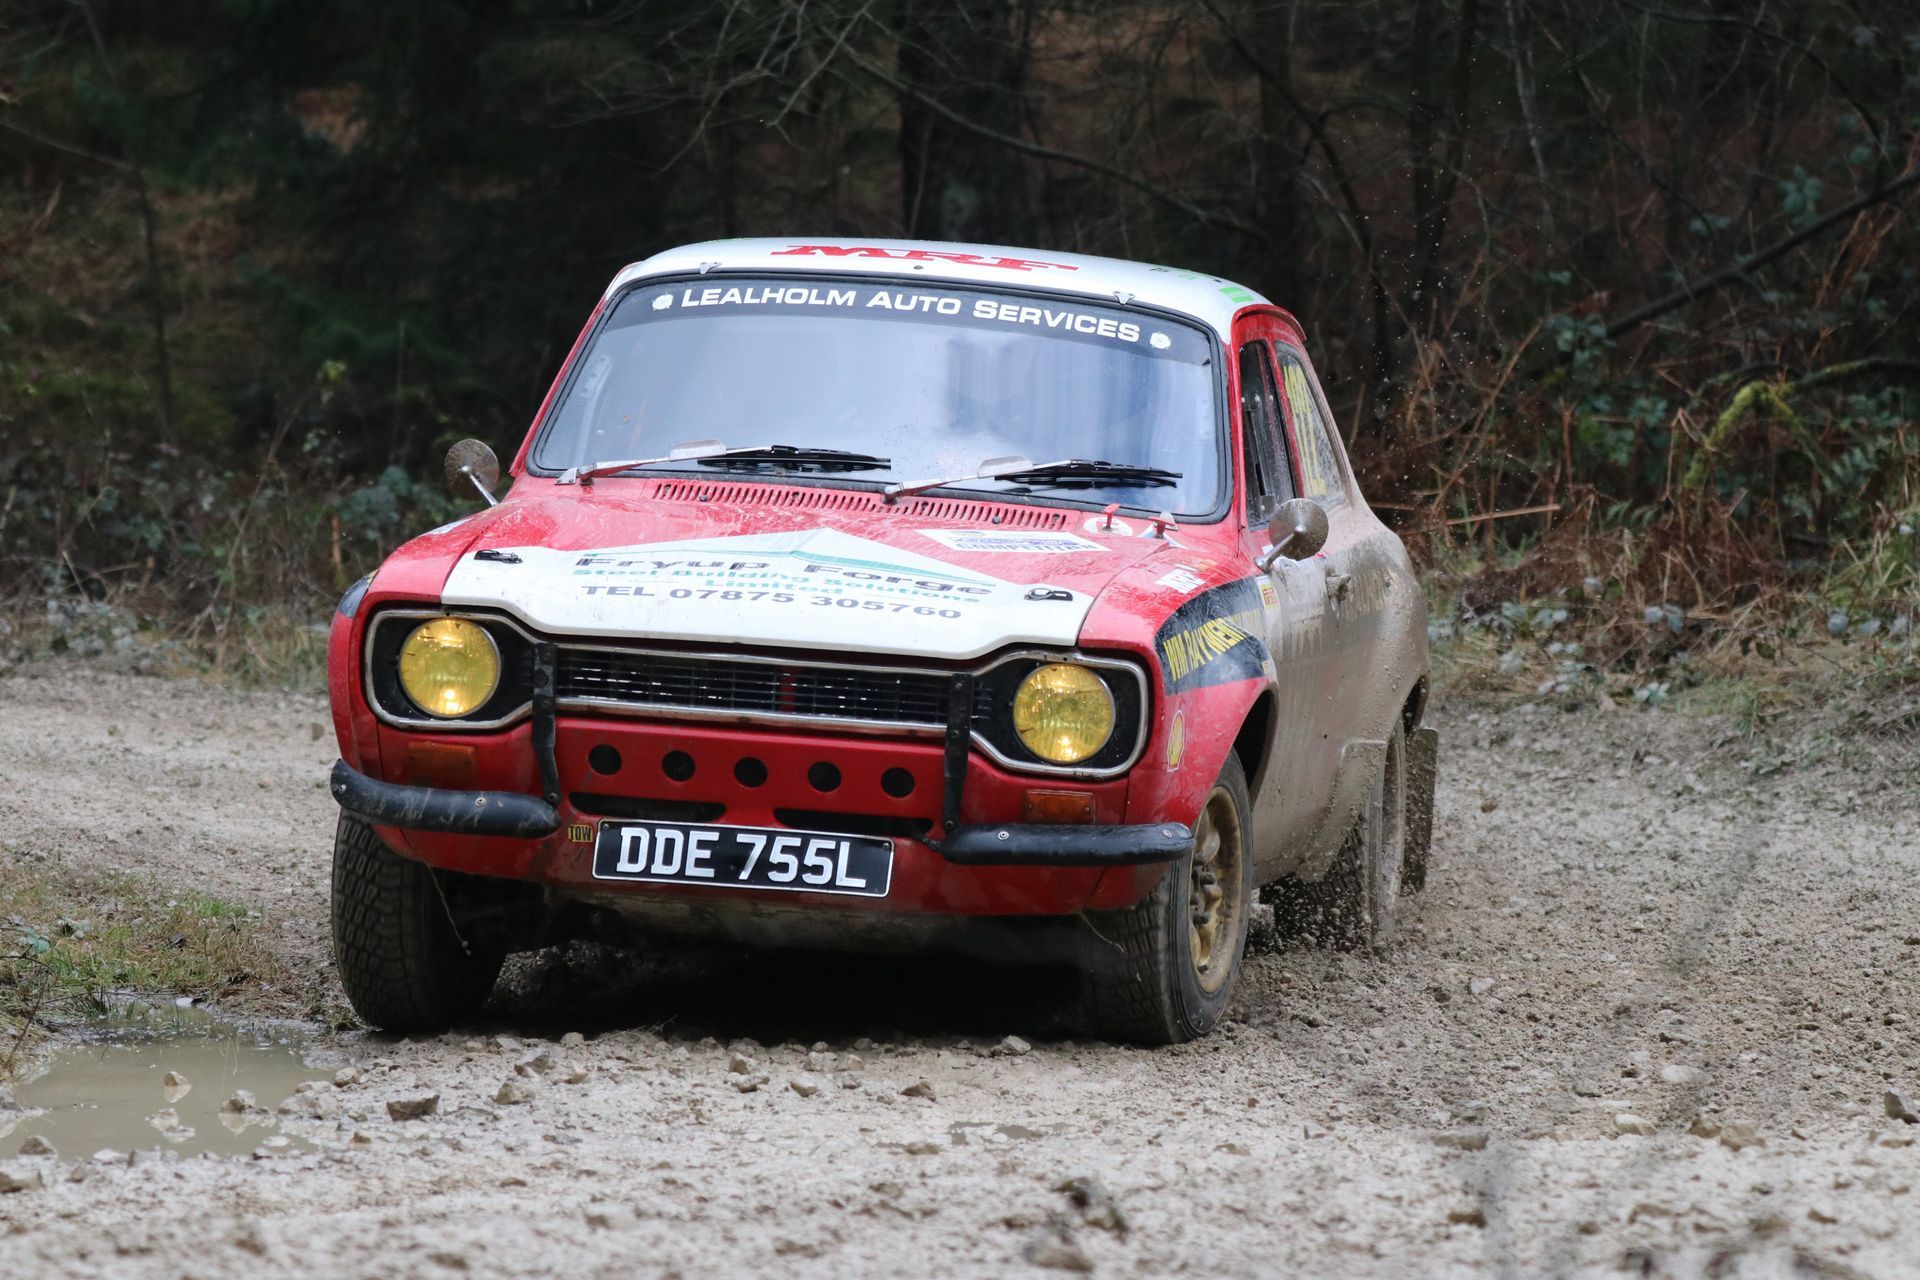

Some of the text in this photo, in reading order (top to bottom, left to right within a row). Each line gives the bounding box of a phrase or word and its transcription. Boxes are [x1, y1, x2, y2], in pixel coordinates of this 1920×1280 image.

[770, 245, 1080, 272] MRF
[681, 287, 1141, 343] LEALHOLM AUTO SERVICES
[575, 558, 993, 595] Fryup Forge
[705, 579, 844, 594] Limited
[580, 585, 962, 619] TEL 07875 305760
[568, 825, 593, 842] TOW
[616, 827, 867, 888] DDE 755L
